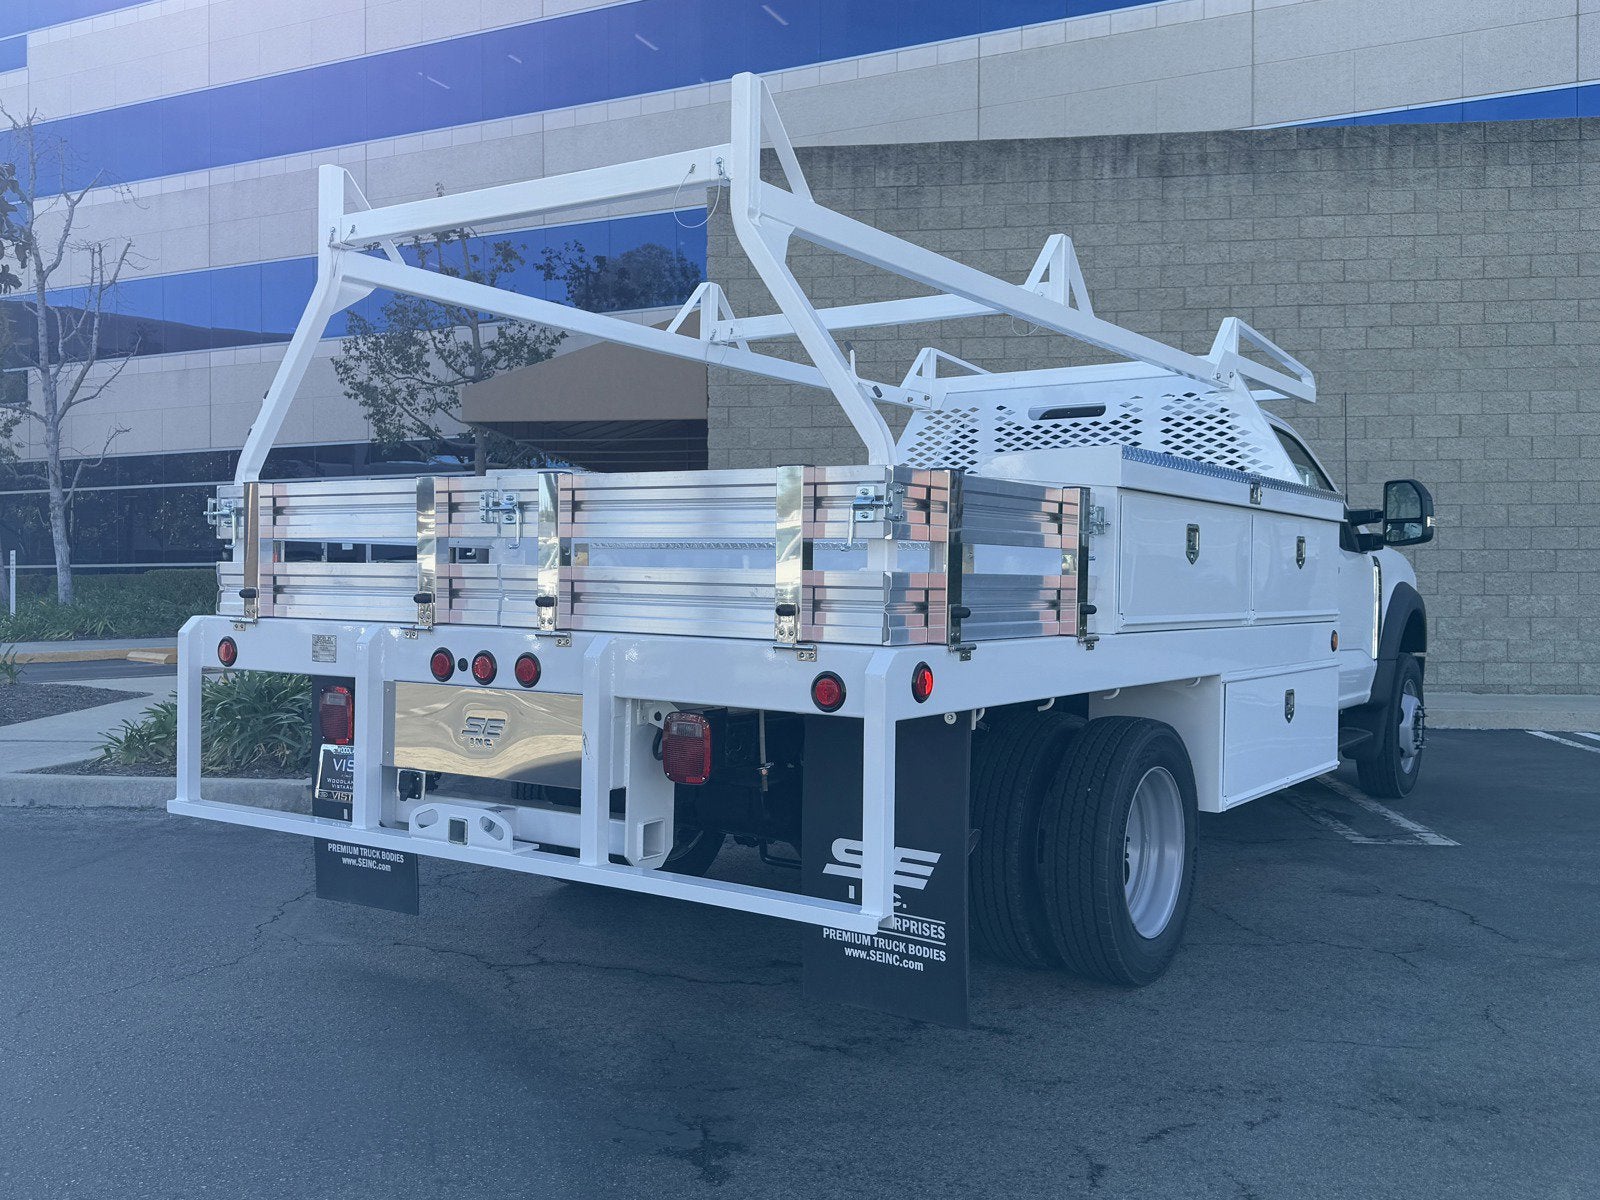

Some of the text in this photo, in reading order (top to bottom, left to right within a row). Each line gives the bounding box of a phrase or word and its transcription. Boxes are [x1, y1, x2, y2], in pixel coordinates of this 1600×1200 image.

[462, 716, 506, 736] SE
[327, 842, 405, 863] PREMIUM TRUCK BODIES
[341, 856, 392, 872] www.SEINC.com
[848, 885, 907, 909] IC.
[894, 917, 946, 940] RPRISES
[822, 927, 947, 962] PREMIUM TRUCK BODIES
[844, 946, 924, 972] www.SEINC.com
